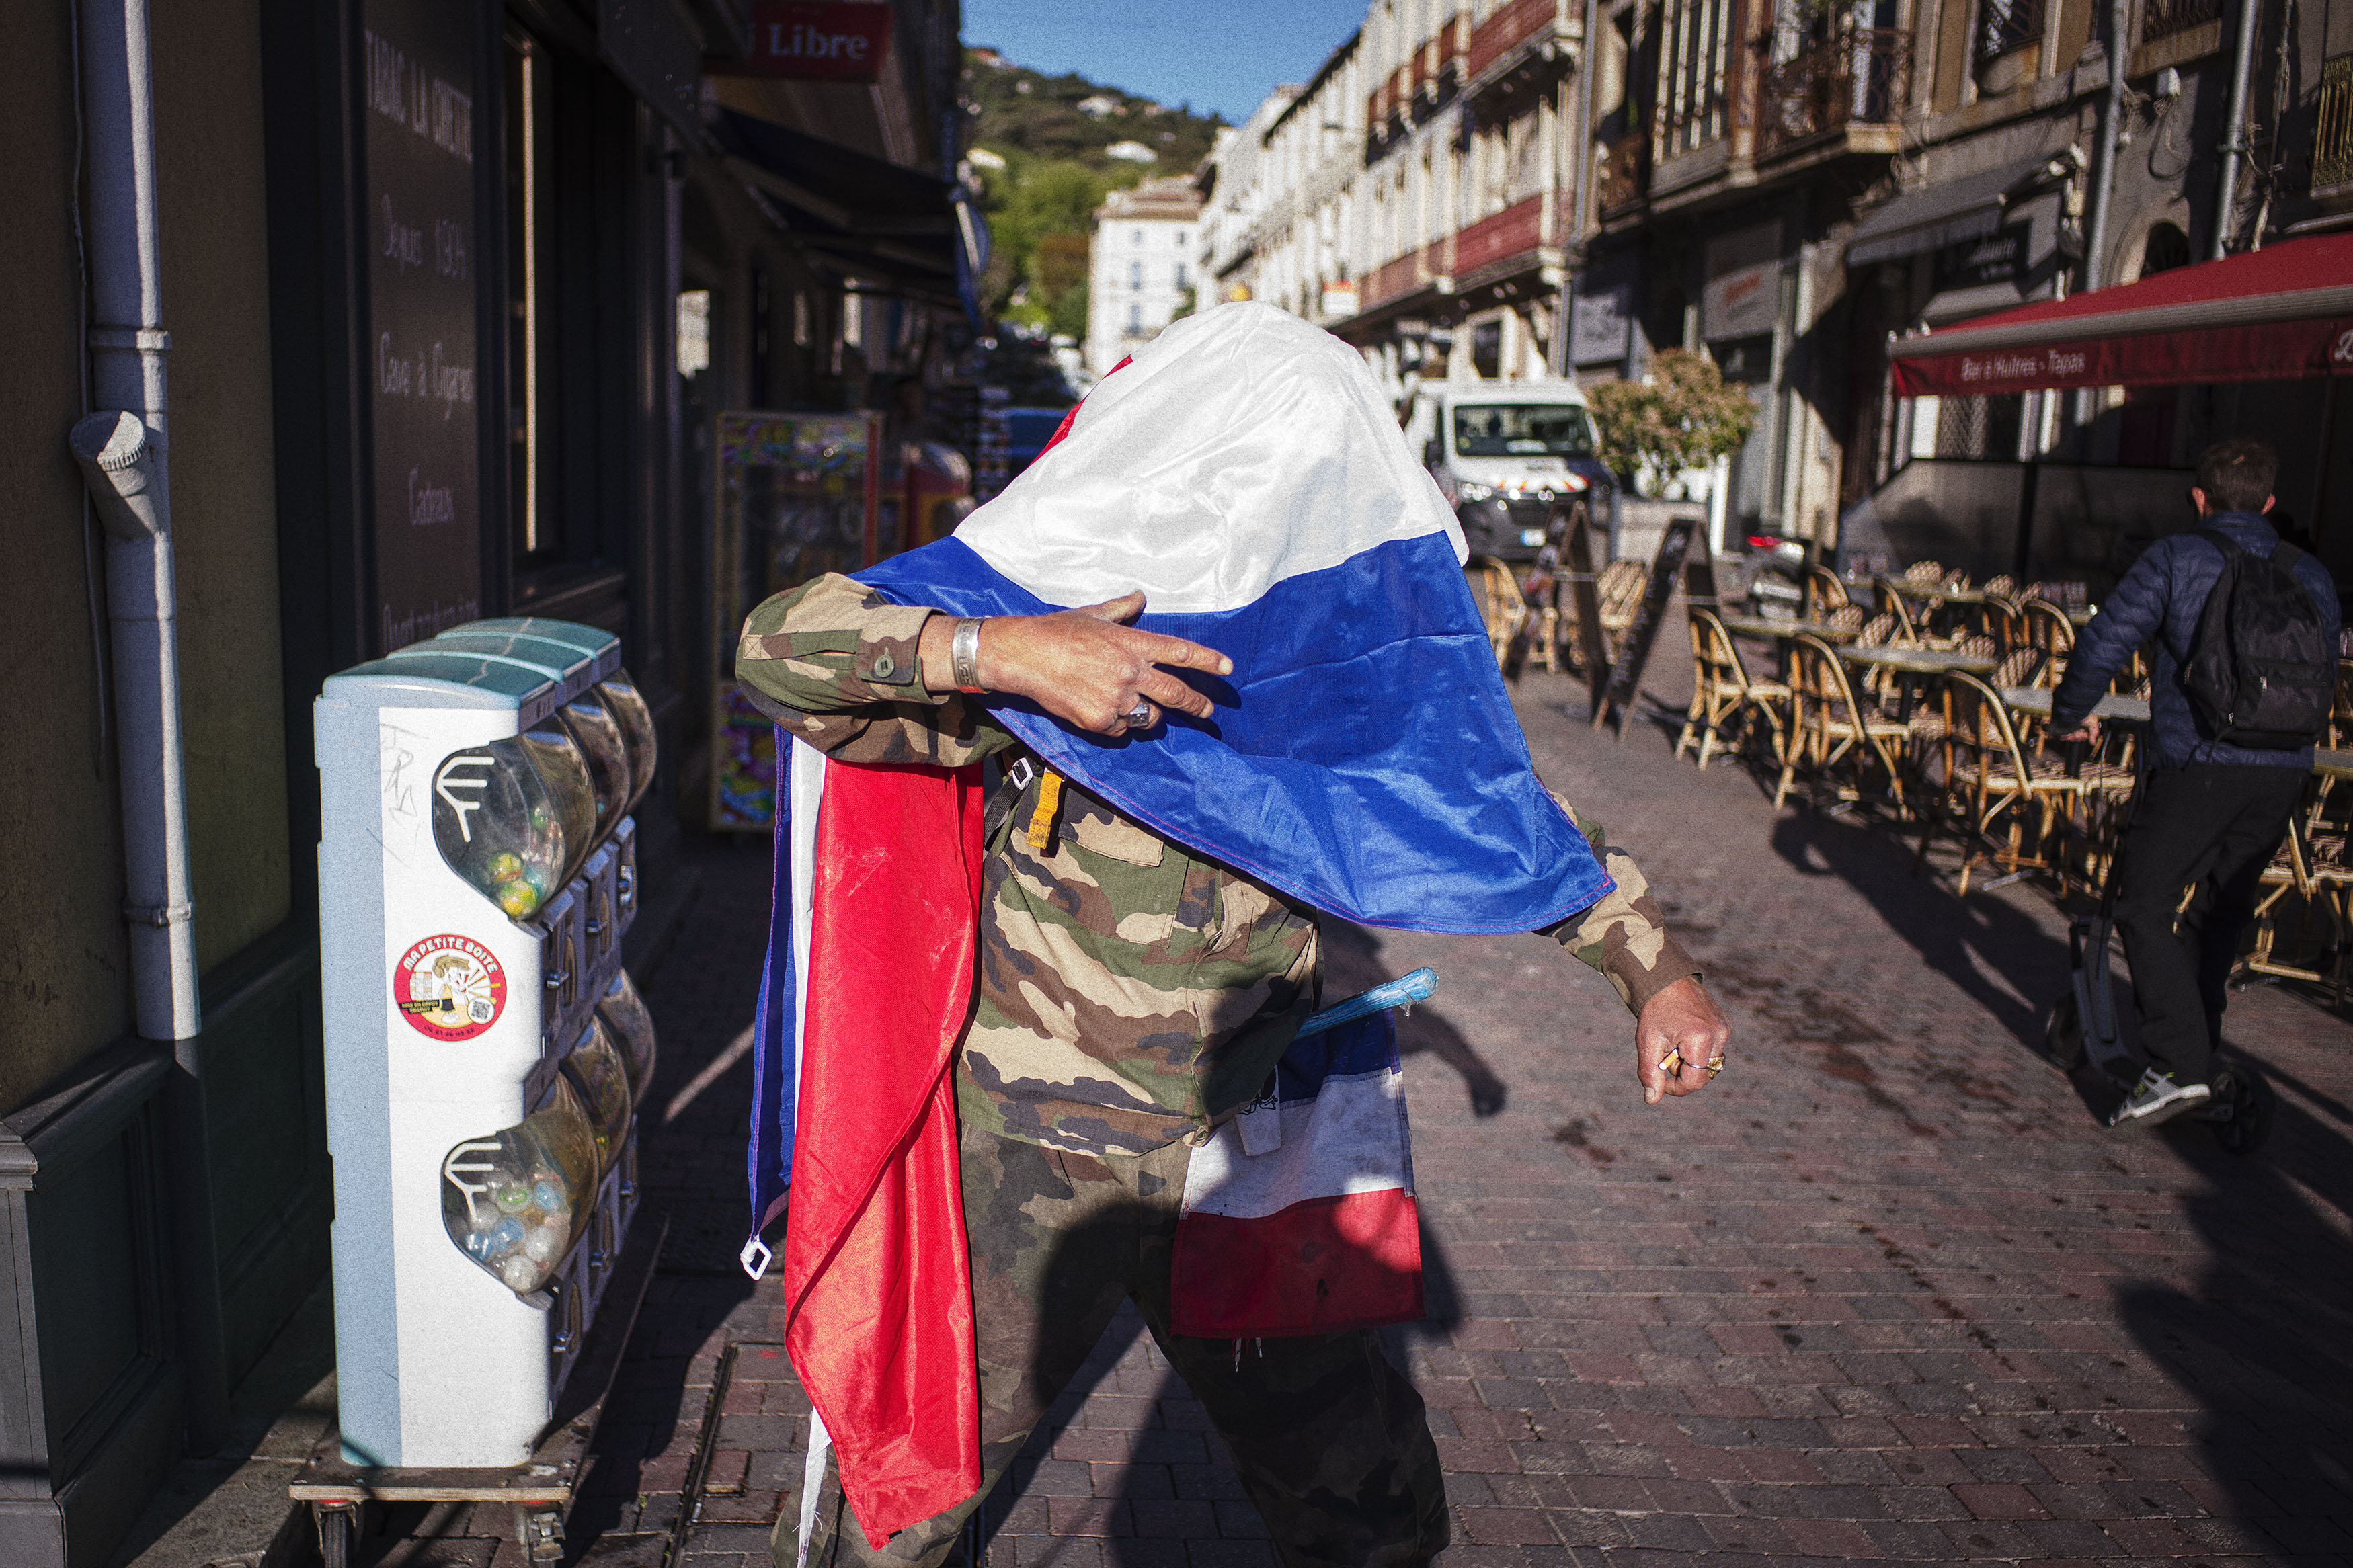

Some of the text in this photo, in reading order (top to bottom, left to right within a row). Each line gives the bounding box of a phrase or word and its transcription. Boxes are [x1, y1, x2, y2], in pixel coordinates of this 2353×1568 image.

[768, 22, 869, 60] Libre
[365, 29, 406, 124] TABAC
[411, 59, 429, 138] LA
[381, 193, 424, 276] Depuis
[379, 330, 411, 397] Cave
[1961, 357, 1982, 382] Bar
[2048, 349, 2086, 378] Tapas
[403, 936, 498, 974] MA PETITE BOITE
